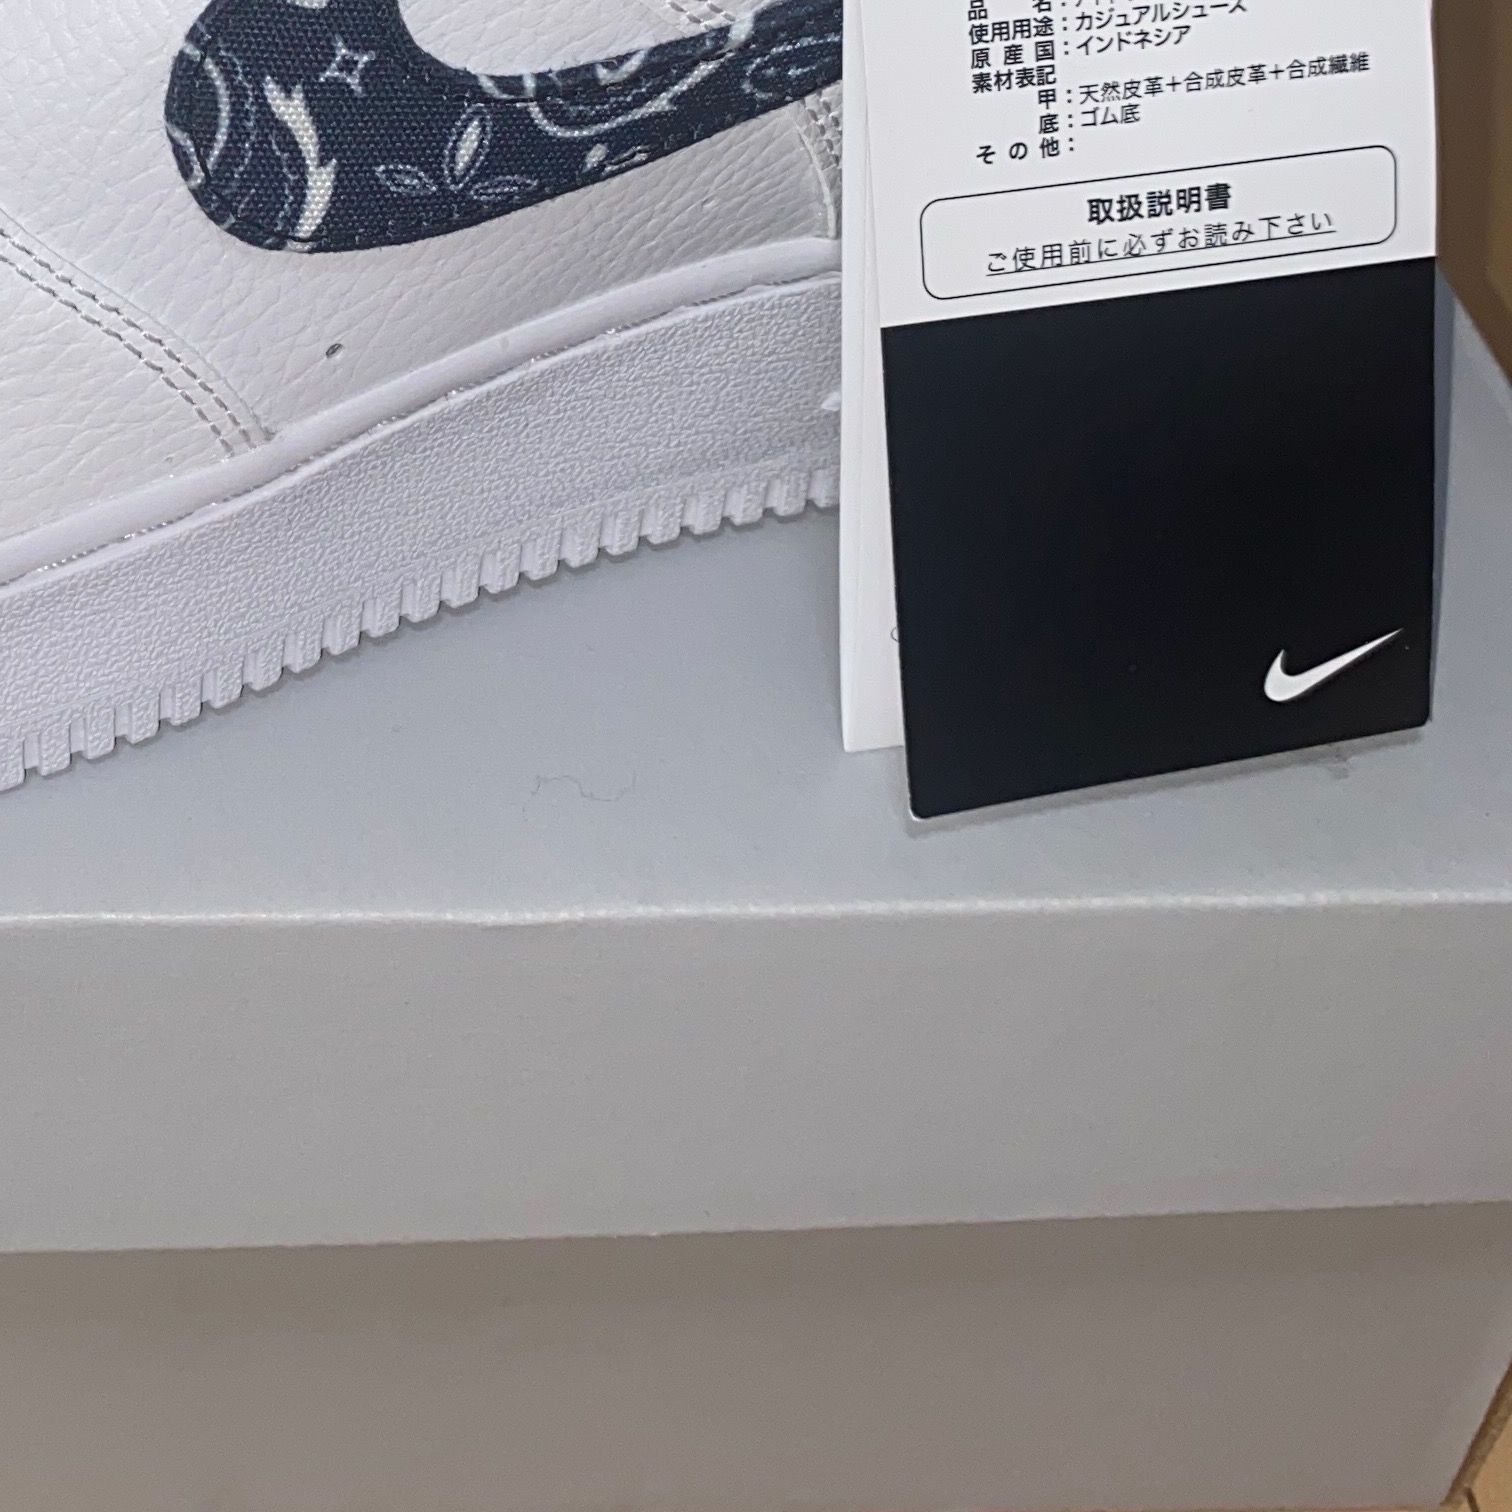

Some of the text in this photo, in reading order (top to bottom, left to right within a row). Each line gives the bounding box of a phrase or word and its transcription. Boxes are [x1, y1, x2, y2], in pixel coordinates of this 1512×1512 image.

[1076, 24, 1192, 56] インドネシア
[972, 64, 1057, 94] 素材表記
[1081, 102, 1141, 127] ゴム底
[1087, 182, 1232, 225] 取扱説明書
[987, 211, 1333, 274] ご使用前に必ずお読み下さい
